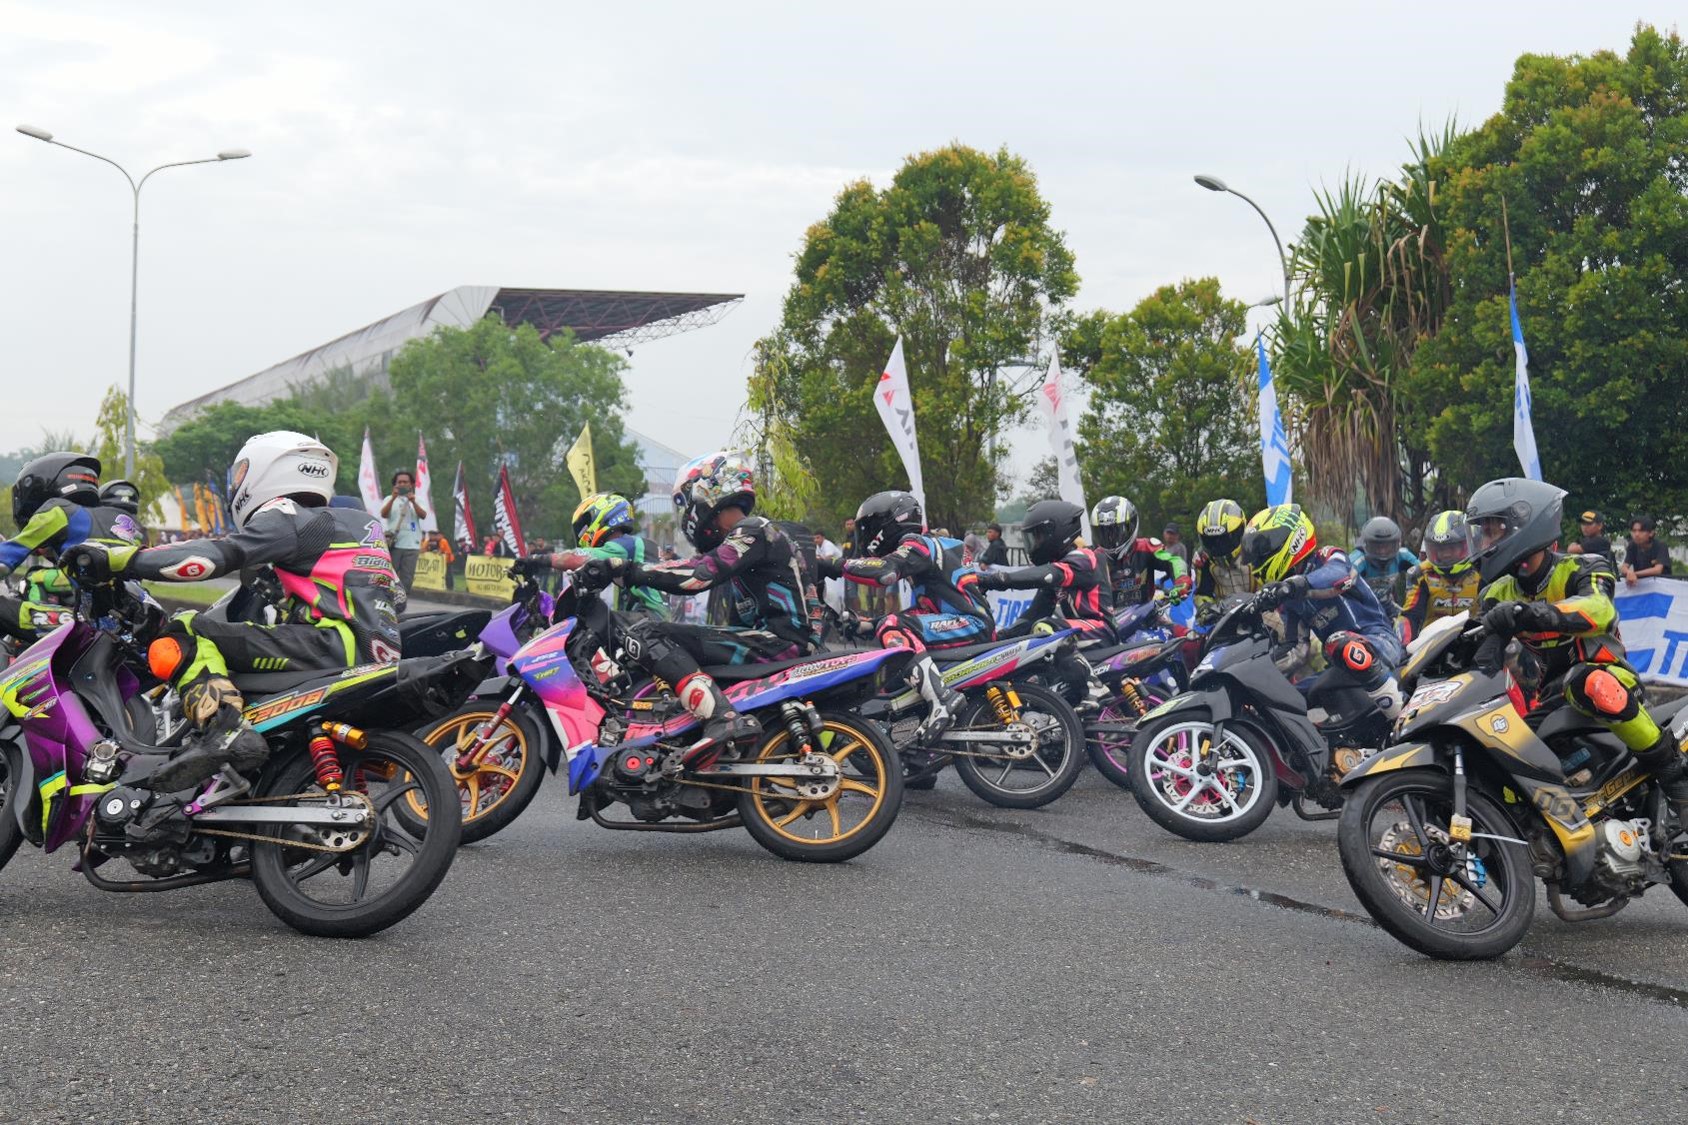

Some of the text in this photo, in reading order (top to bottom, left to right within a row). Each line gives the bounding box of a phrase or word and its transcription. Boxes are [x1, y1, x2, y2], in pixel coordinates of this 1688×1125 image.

[301, 465, 325, 476] NHK
[235, 485, 250, 515] NHK
[867, 529, 884, 553] KYT
[1291, 529, 1305, 552] NHK
